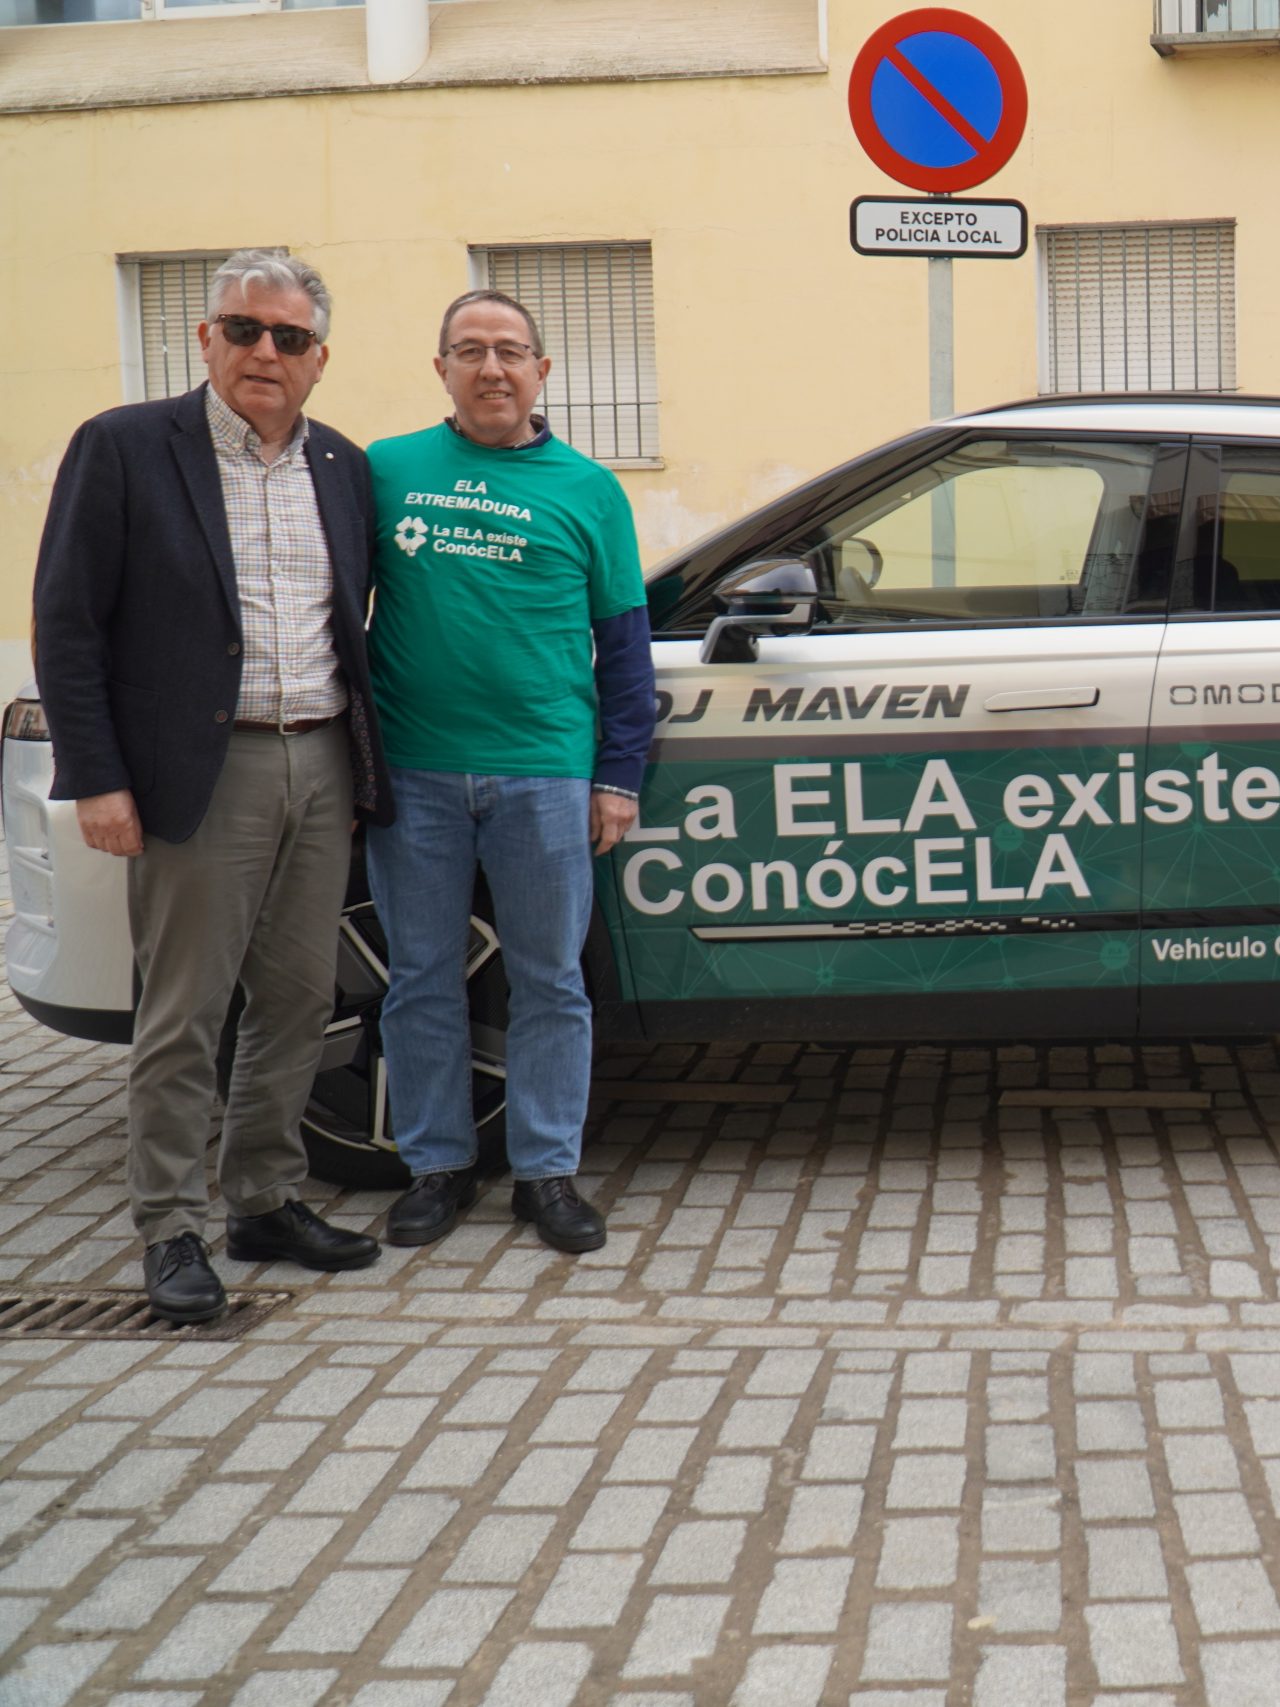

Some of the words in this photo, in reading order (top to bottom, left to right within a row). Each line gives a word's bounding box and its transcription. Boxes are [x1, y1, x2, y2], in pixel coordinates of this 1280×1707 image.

[900, 211, 978, 226] EXCEPTO
[875, 228, 941, 242] POLICIA
[947, 230, 1002, 244] LOCAL
[454, 480, 487, 494] ELA
[404, 492, 532, 521] EXTREMADURA
[432, 524, 450, 537] La
[453, 526, 483, 541] ELA
[486, 531, 528, 547] existe
[433, 538, 523, 562] ConócELA
[742, 684, 971, 722] MAVEN
[623, 784, 738, 842] La
[773, 758, 977, 836] ELA
[623, 833, 1091, 915] ConócELA
[1151, 936, 1266, 961] Vehículo
